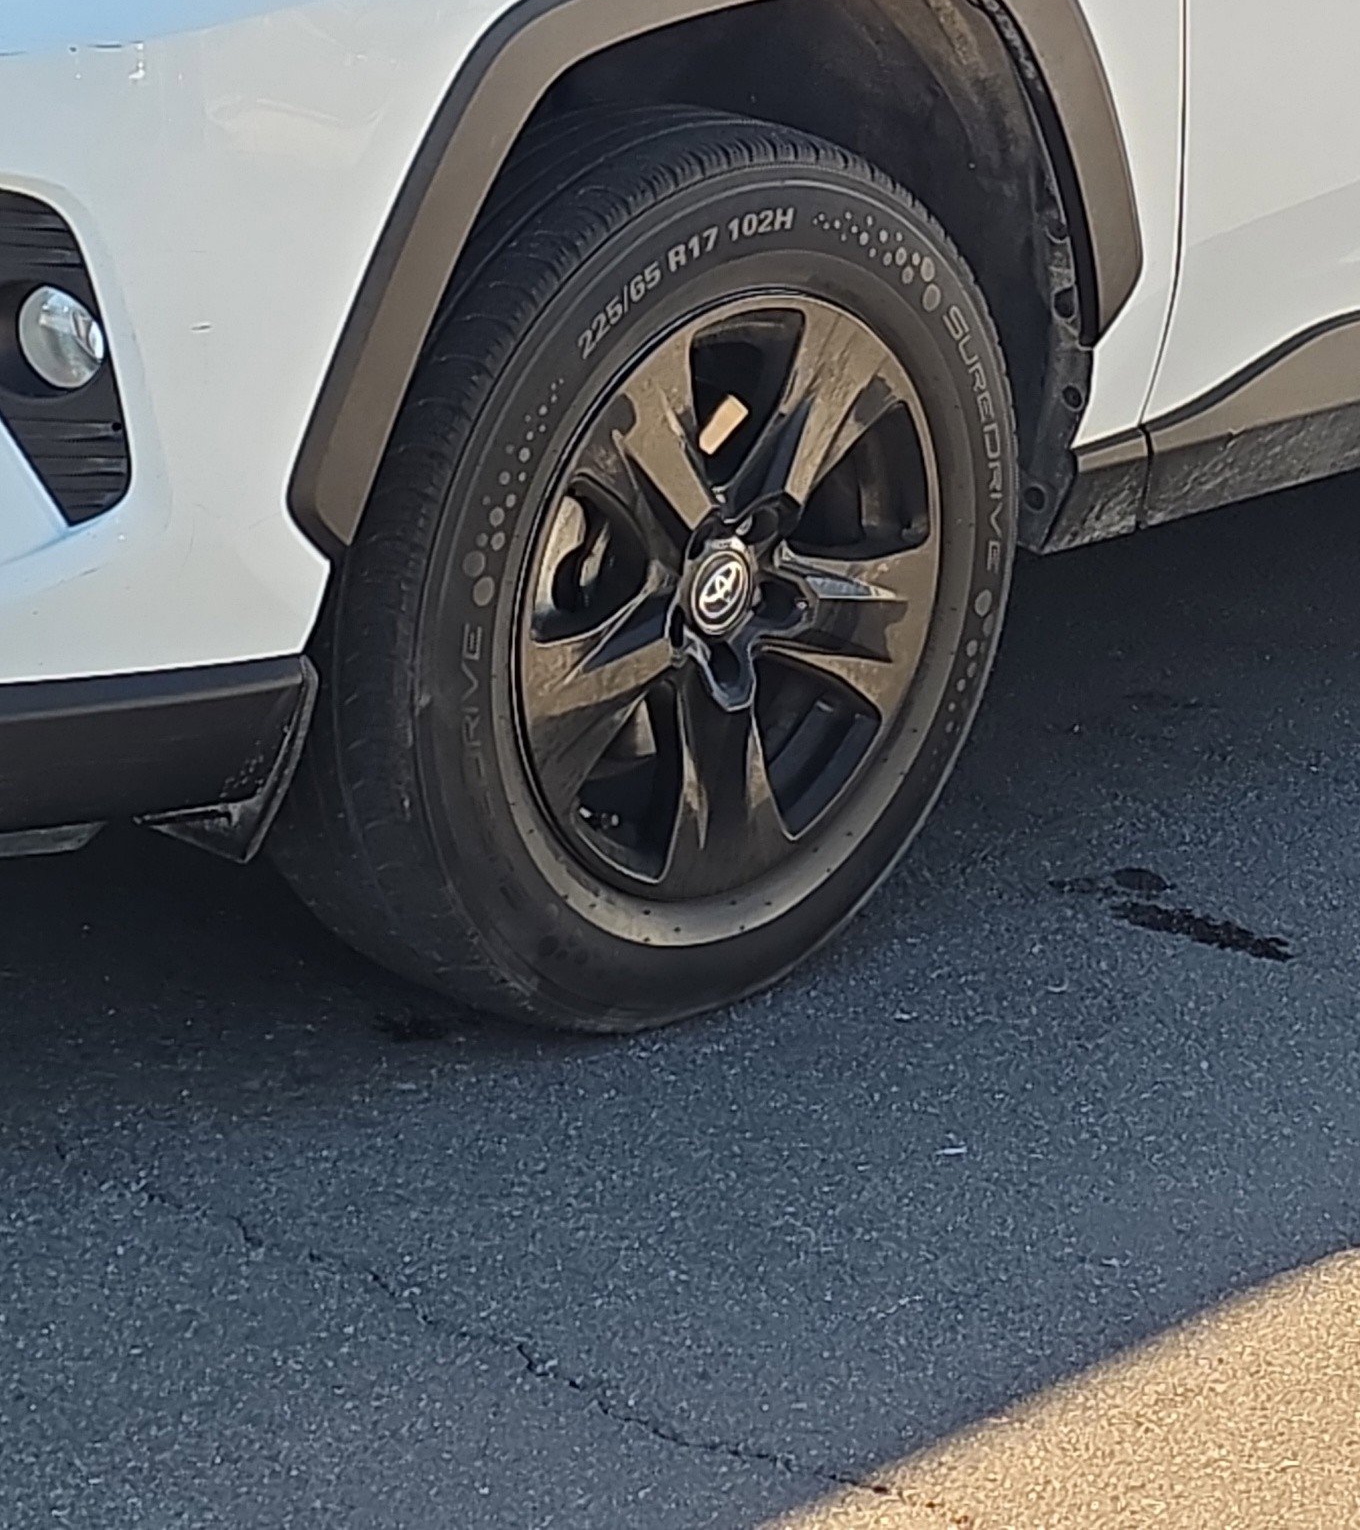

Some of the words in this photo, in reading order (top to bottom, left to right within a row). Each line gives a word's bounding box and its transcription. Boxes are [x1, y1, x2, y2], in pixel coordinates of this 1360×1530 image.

[577, 260, 662, 360] 225/65
[667, 226, 719, 272] R17
[727, 207, 795, 242] 102H
[942, 304, 1002, 574] SUREDRIVE
